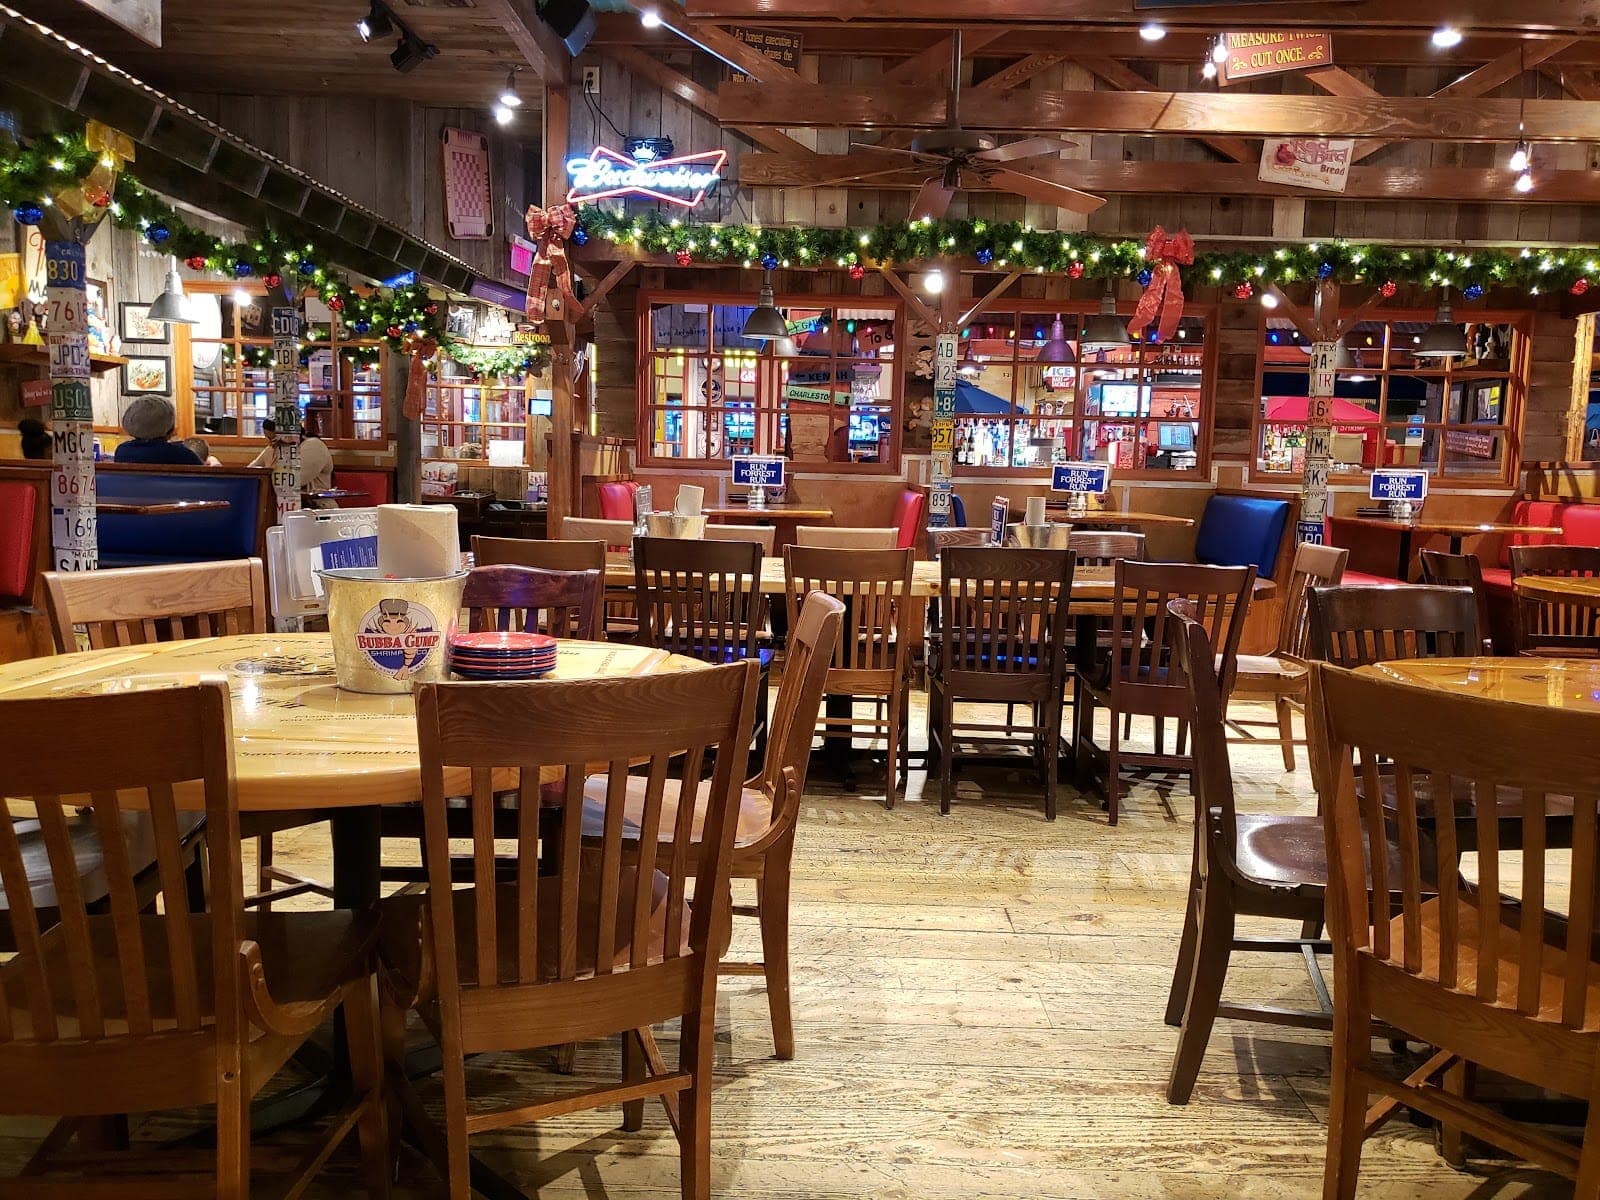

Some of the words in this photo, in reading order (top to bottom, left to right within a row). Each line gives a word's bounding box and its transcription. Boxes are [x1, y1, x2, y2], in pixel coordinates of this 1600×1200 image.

[1231, 33, 1284, 48] MEASURE
[1251, 52, 1273, 68] CUT
[1320, 164, 1345, 176] Bread
[47, 259, 79, 281] 830
[1052, 368, 1070, 376] ICE
[789, 390, 830, 400] CHARLESTO
[750, 463, 768, 471] RUN
[740, 469, 777, 478] FORREST
[1070, 470, 1089, 478] RUN
[749, 476, 768, 484] RUN
[1060, 475, 1098, 485] FORREST
[1389, 477, 1408, 485] RUN
[1069, 483, 1088, 491] RUN
[1379, 483, 1417, 492] FORREST
[357, 635, 402, 649] BUBBA
[405, 634, 439, 648] GUMP
